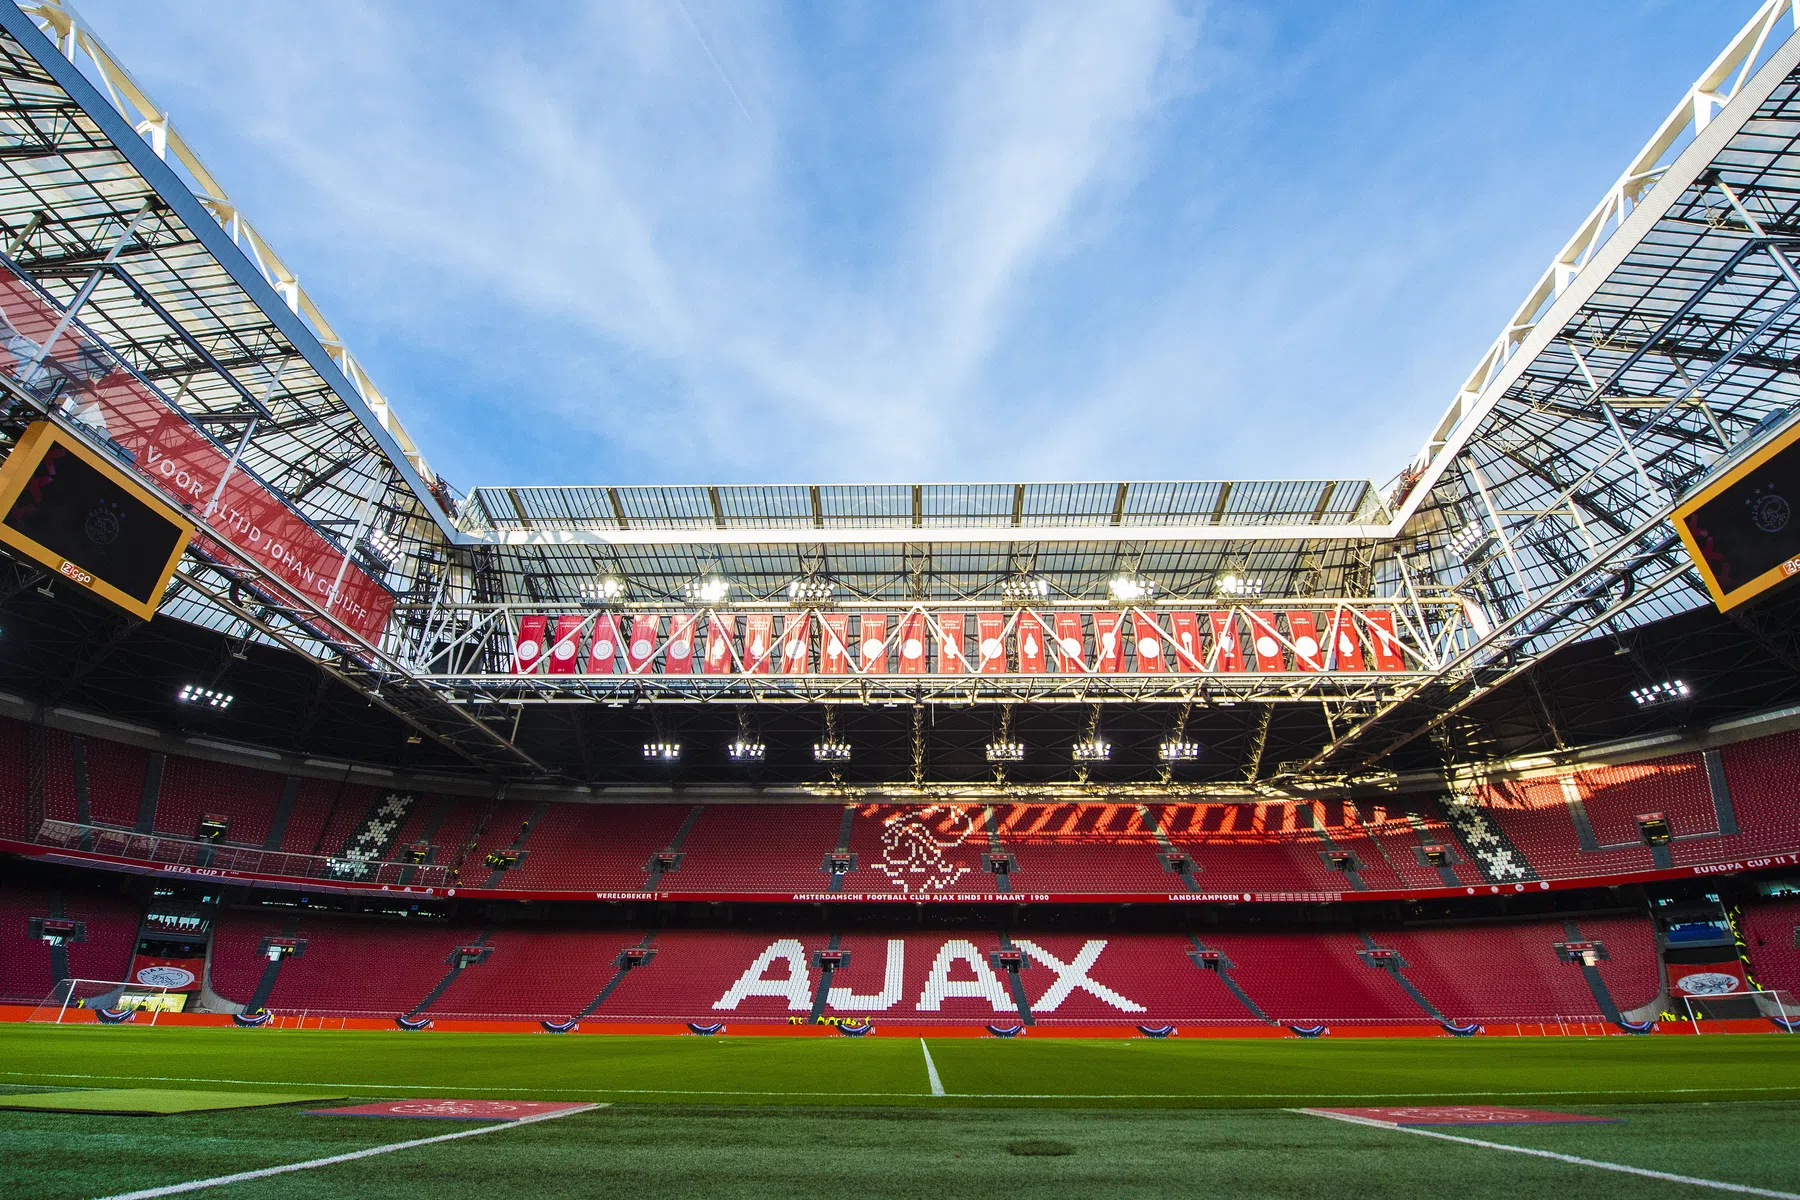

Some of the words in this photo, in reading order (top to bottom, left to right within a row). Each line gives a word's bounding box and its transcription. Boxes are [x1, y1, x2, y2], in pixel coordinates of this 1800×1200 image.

[147, 445, 204, 500] VOOR
[262, 538, 315, 583] JOHAN
[60, 561, 91, 583] Ziggo
[164, 864, 192, 874] UEFA
[196, 868, 217, 877] CUP
[1693, 862, 1743, 874] EUROPA
[1747, 858, 1771, 868] CUP
[933, 894, 955, 902] AJAX
[712, 939, 1147, 1012] AJAX
